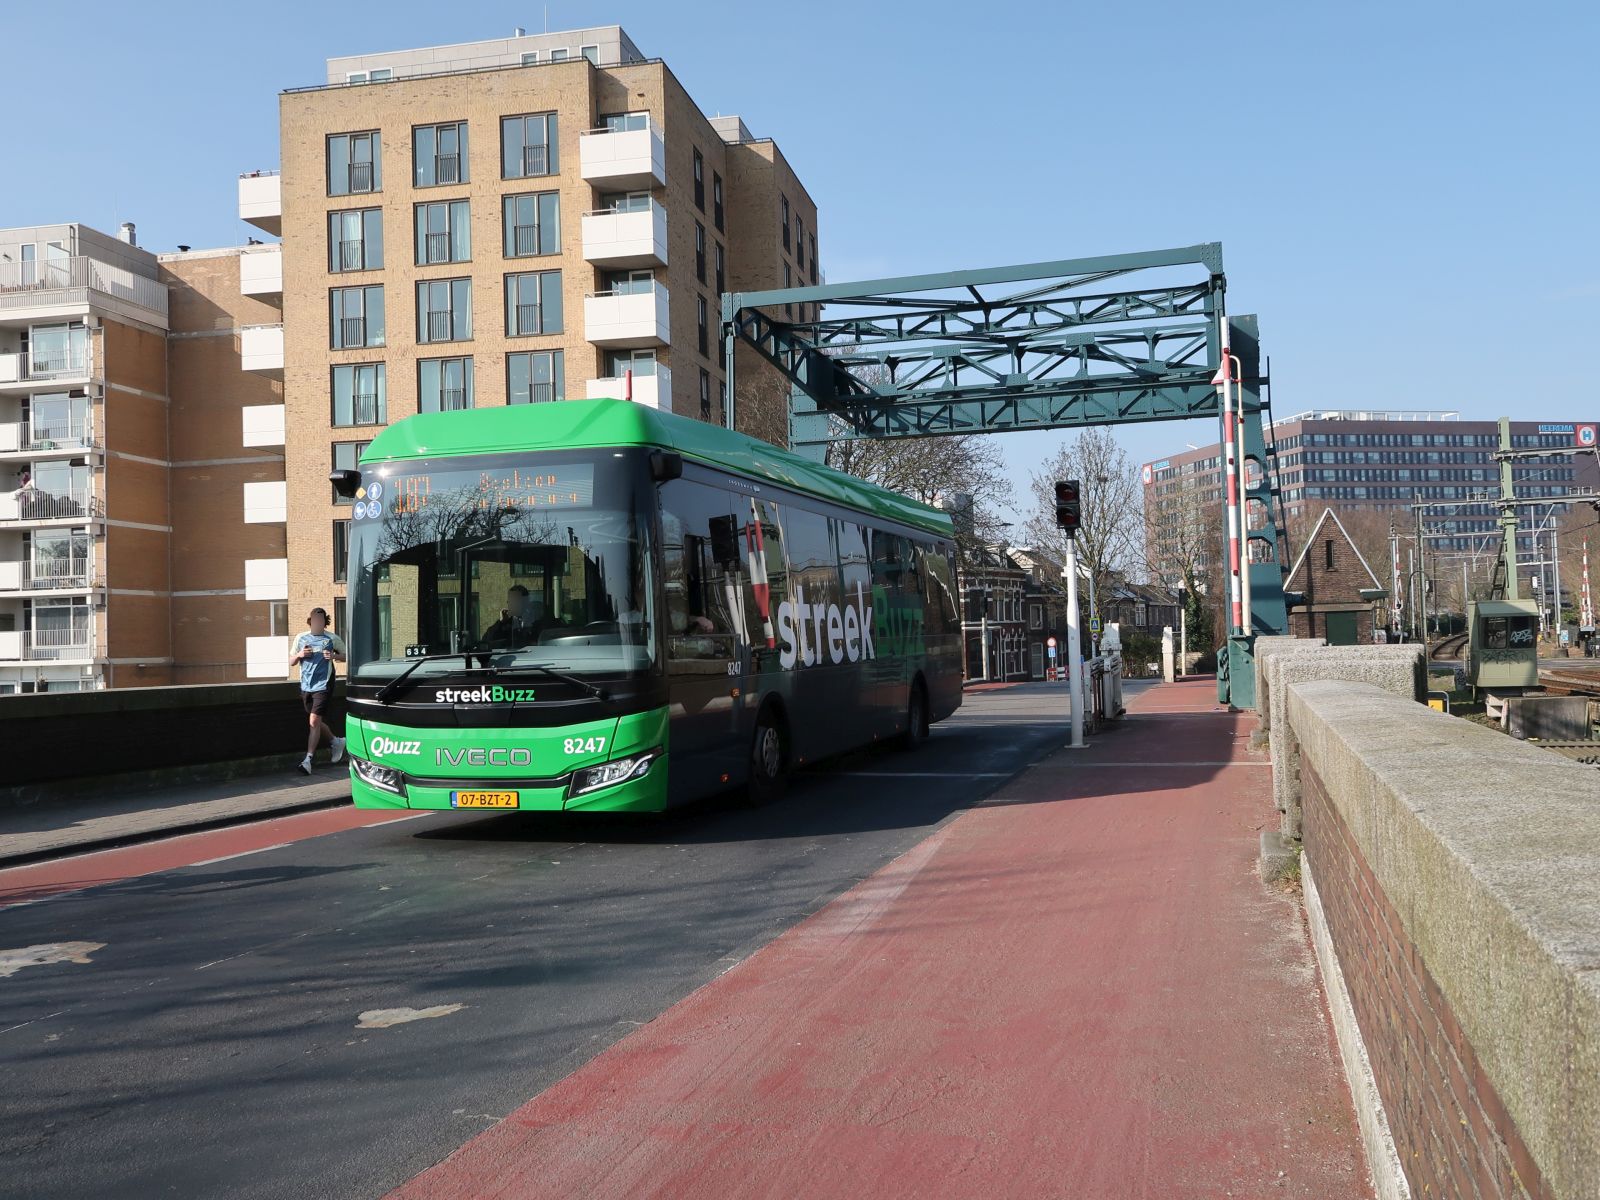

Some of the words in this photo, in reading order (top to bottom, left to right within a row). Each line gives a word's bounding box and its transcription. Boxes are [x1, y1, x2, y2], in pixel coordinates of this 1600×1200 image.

[1582, 430, 1592, 440] H
[727, 661, 741, 676] 8247
[435, 685, 535, 703] streekBuzz
[370, 737, 421, 756] Qbuzz
[563, 737, 606, 754] 8247
[435, 748, 532, 767] IVECO
[461, 794, 512, 806] 07-BZT-2
